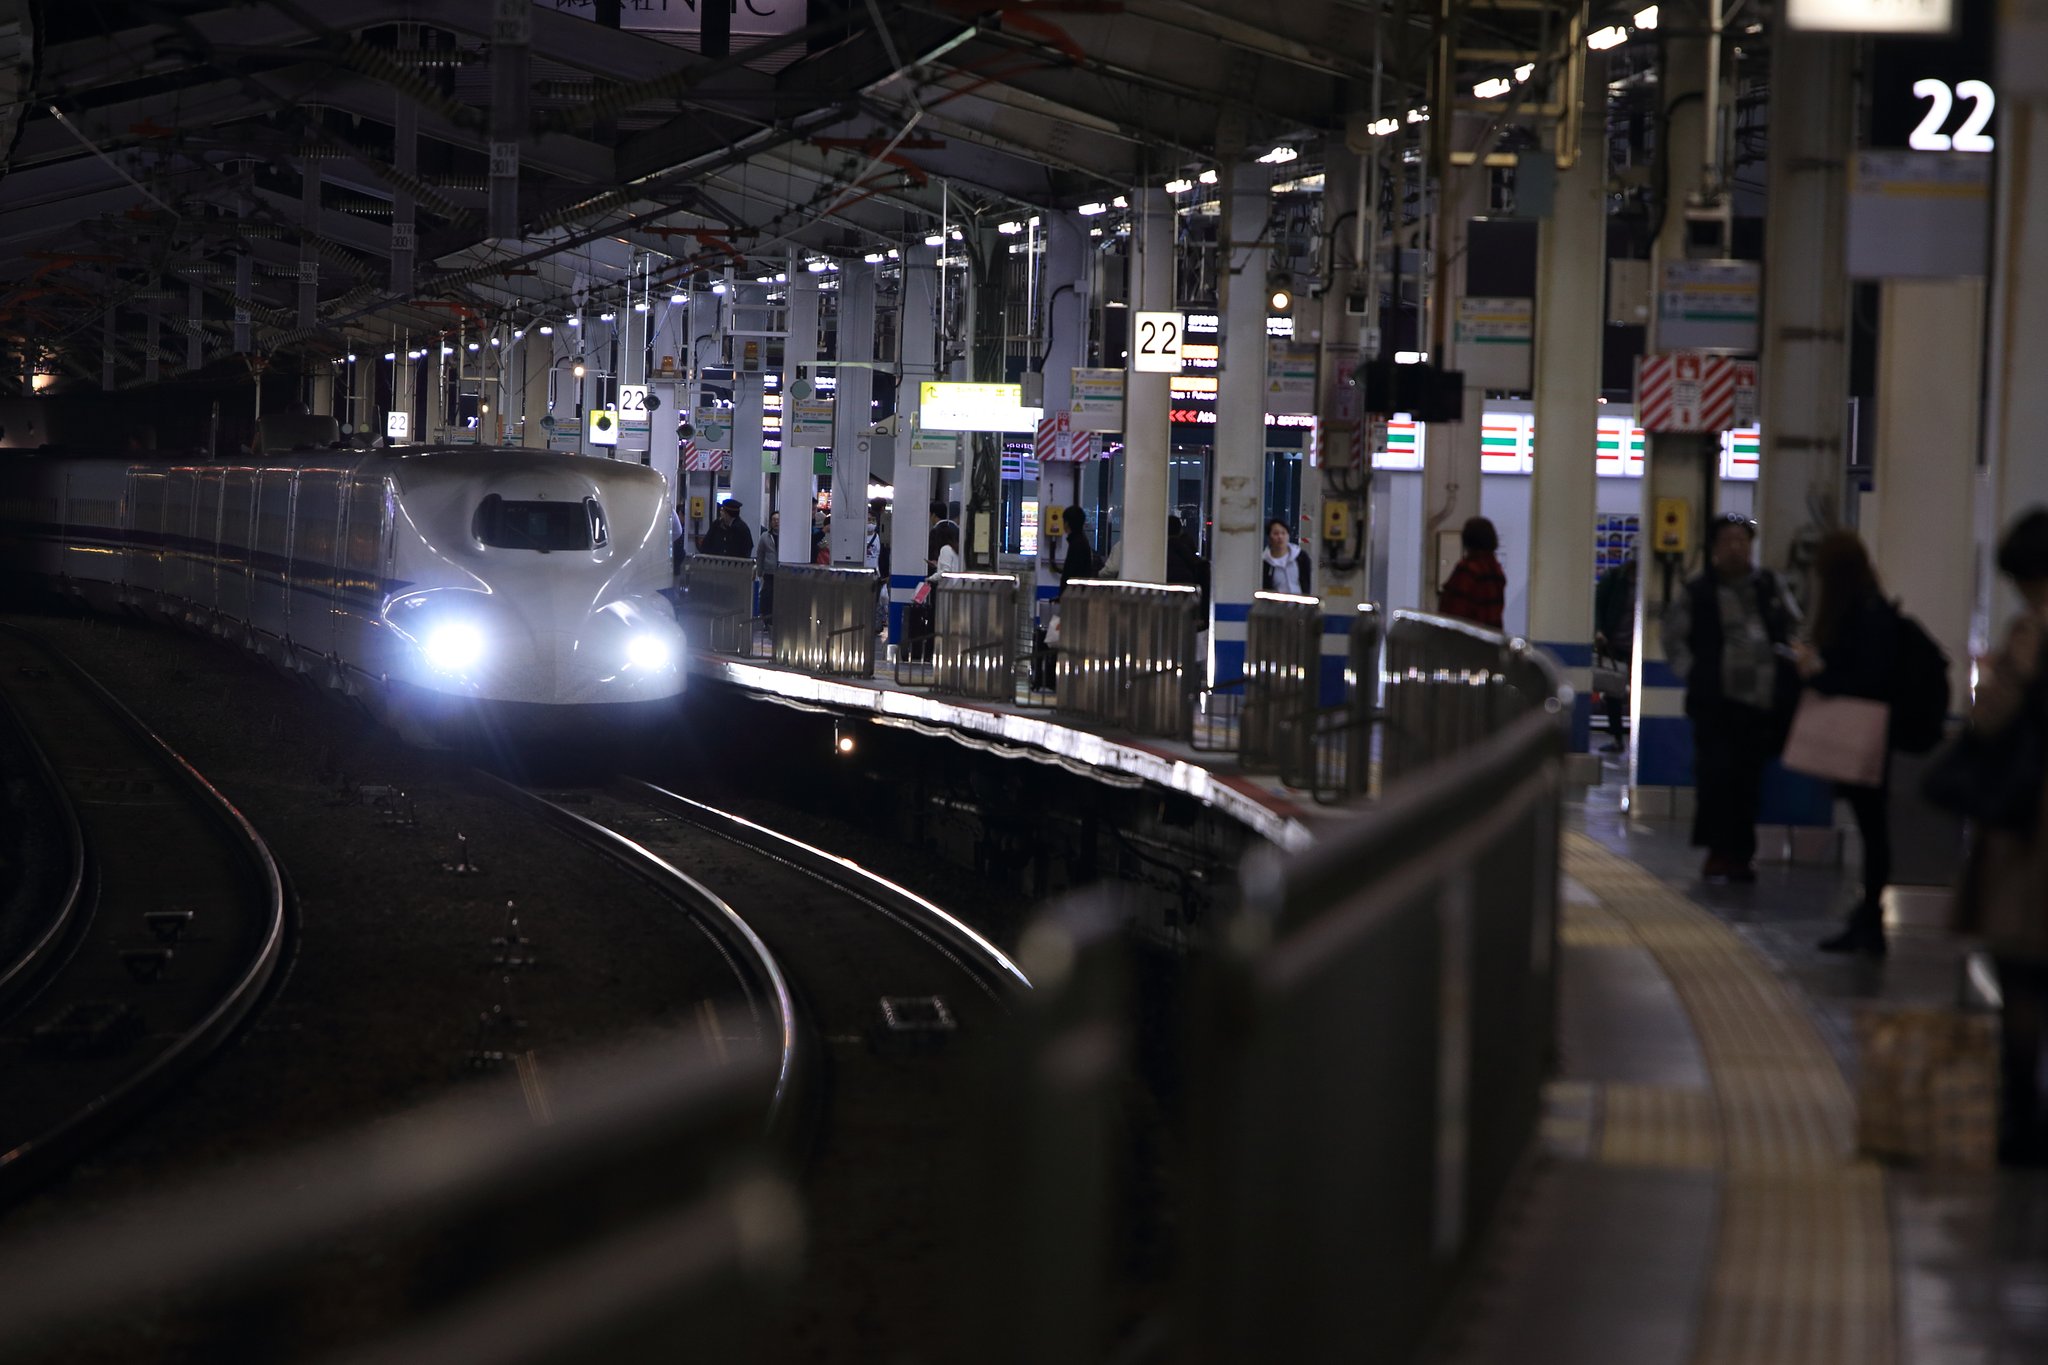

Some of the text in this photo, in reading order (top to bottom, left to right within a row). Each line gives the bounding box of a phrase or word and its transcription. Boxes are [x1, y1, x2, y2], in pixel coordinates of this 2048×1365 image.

[1909, 78, 1995, 151] 22
[1141, 321, 1177, 355] 22
[622, 390, 645, 410] 22
[390, 415, 406, 430] 22
